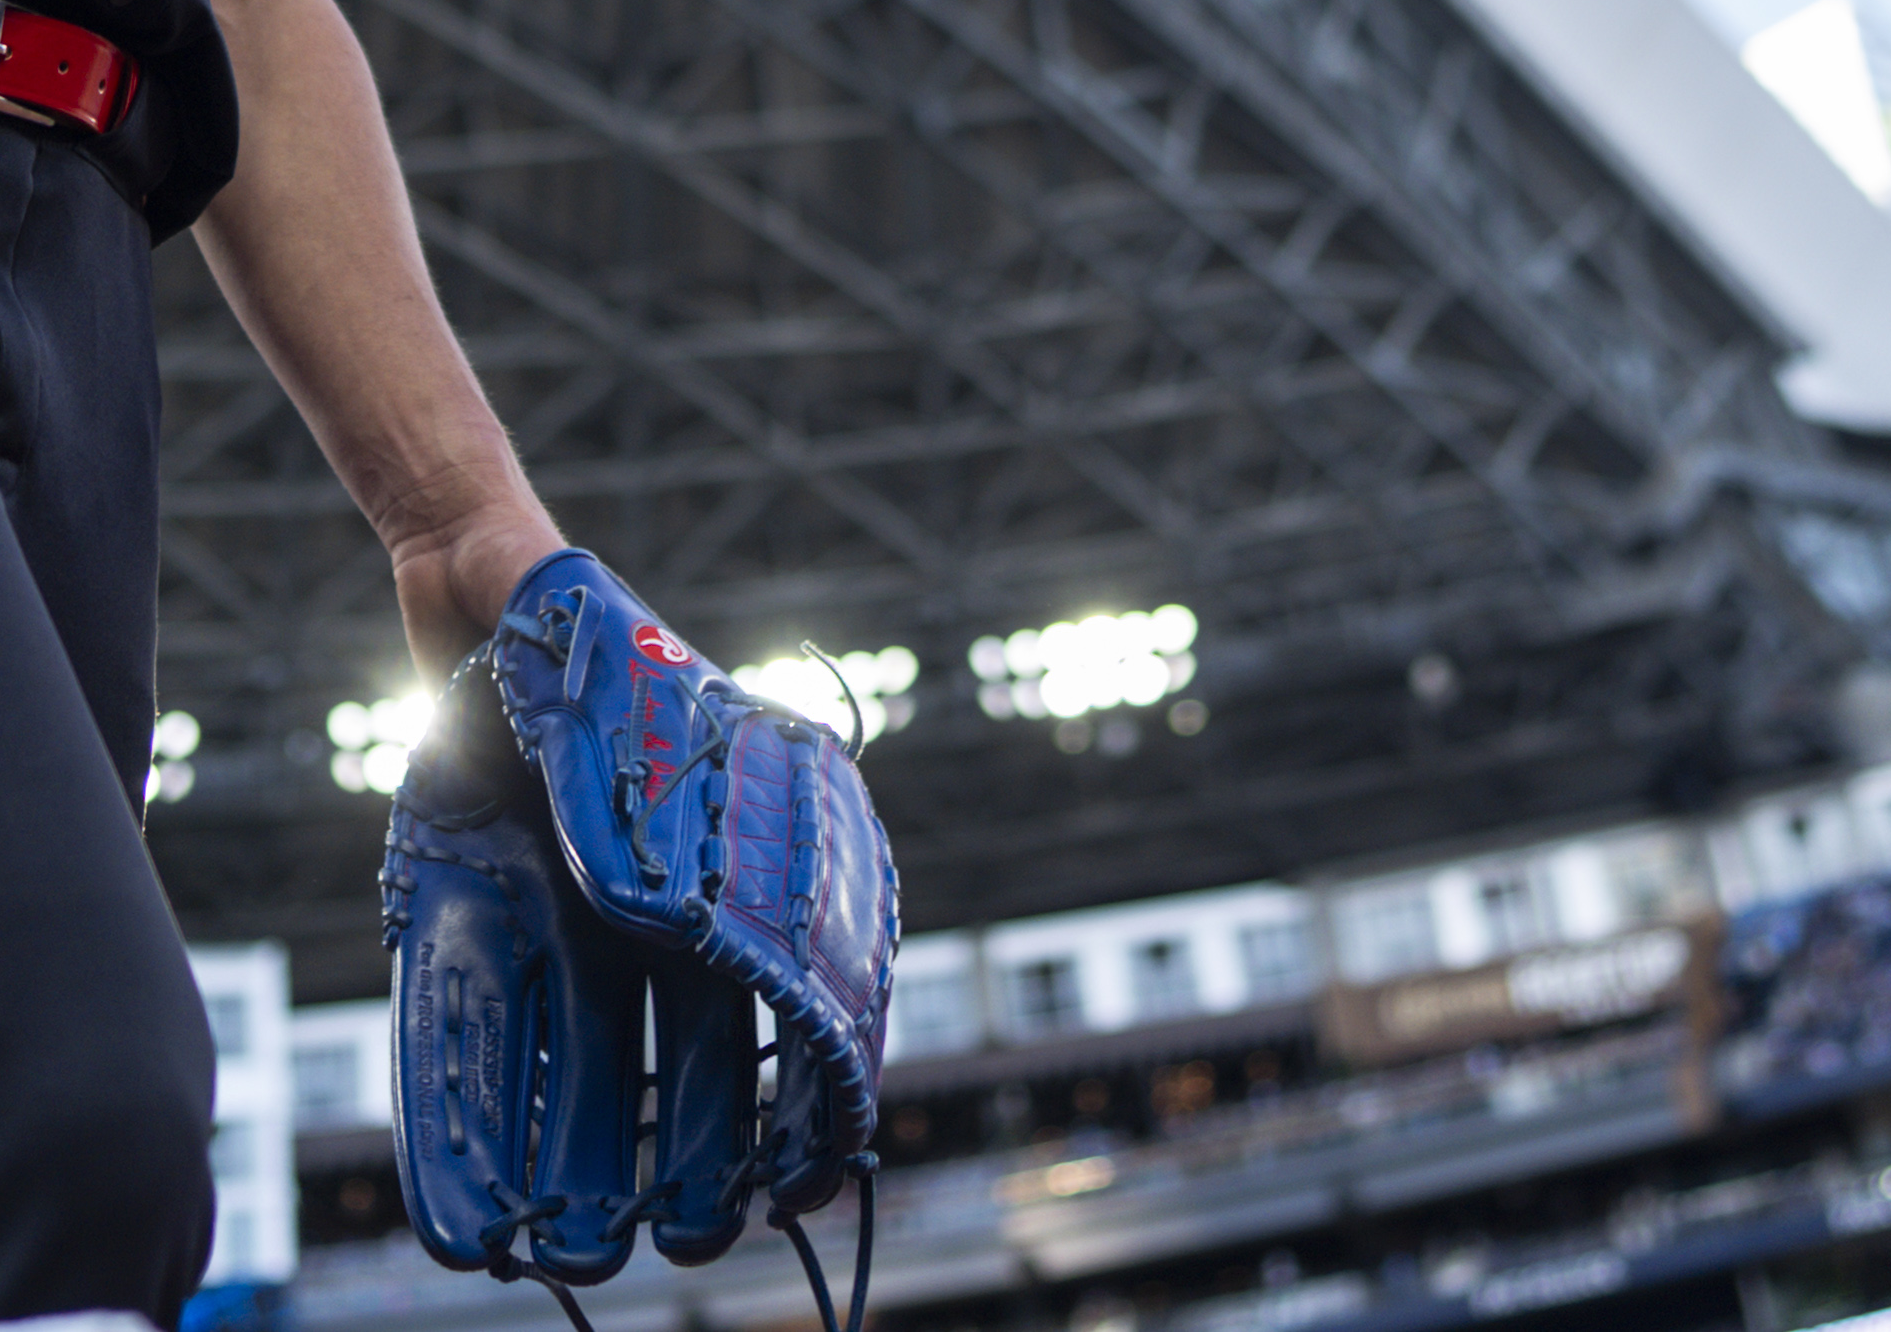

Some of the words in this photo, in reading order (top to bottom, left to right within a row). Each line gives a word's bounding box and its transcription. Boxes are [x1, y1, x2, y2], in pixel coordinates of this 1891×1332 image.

[417, 941, 435, 967] For
[418, 968, 433, 992] the
[417, 993, 435, 1117] PROFESSIONAL
